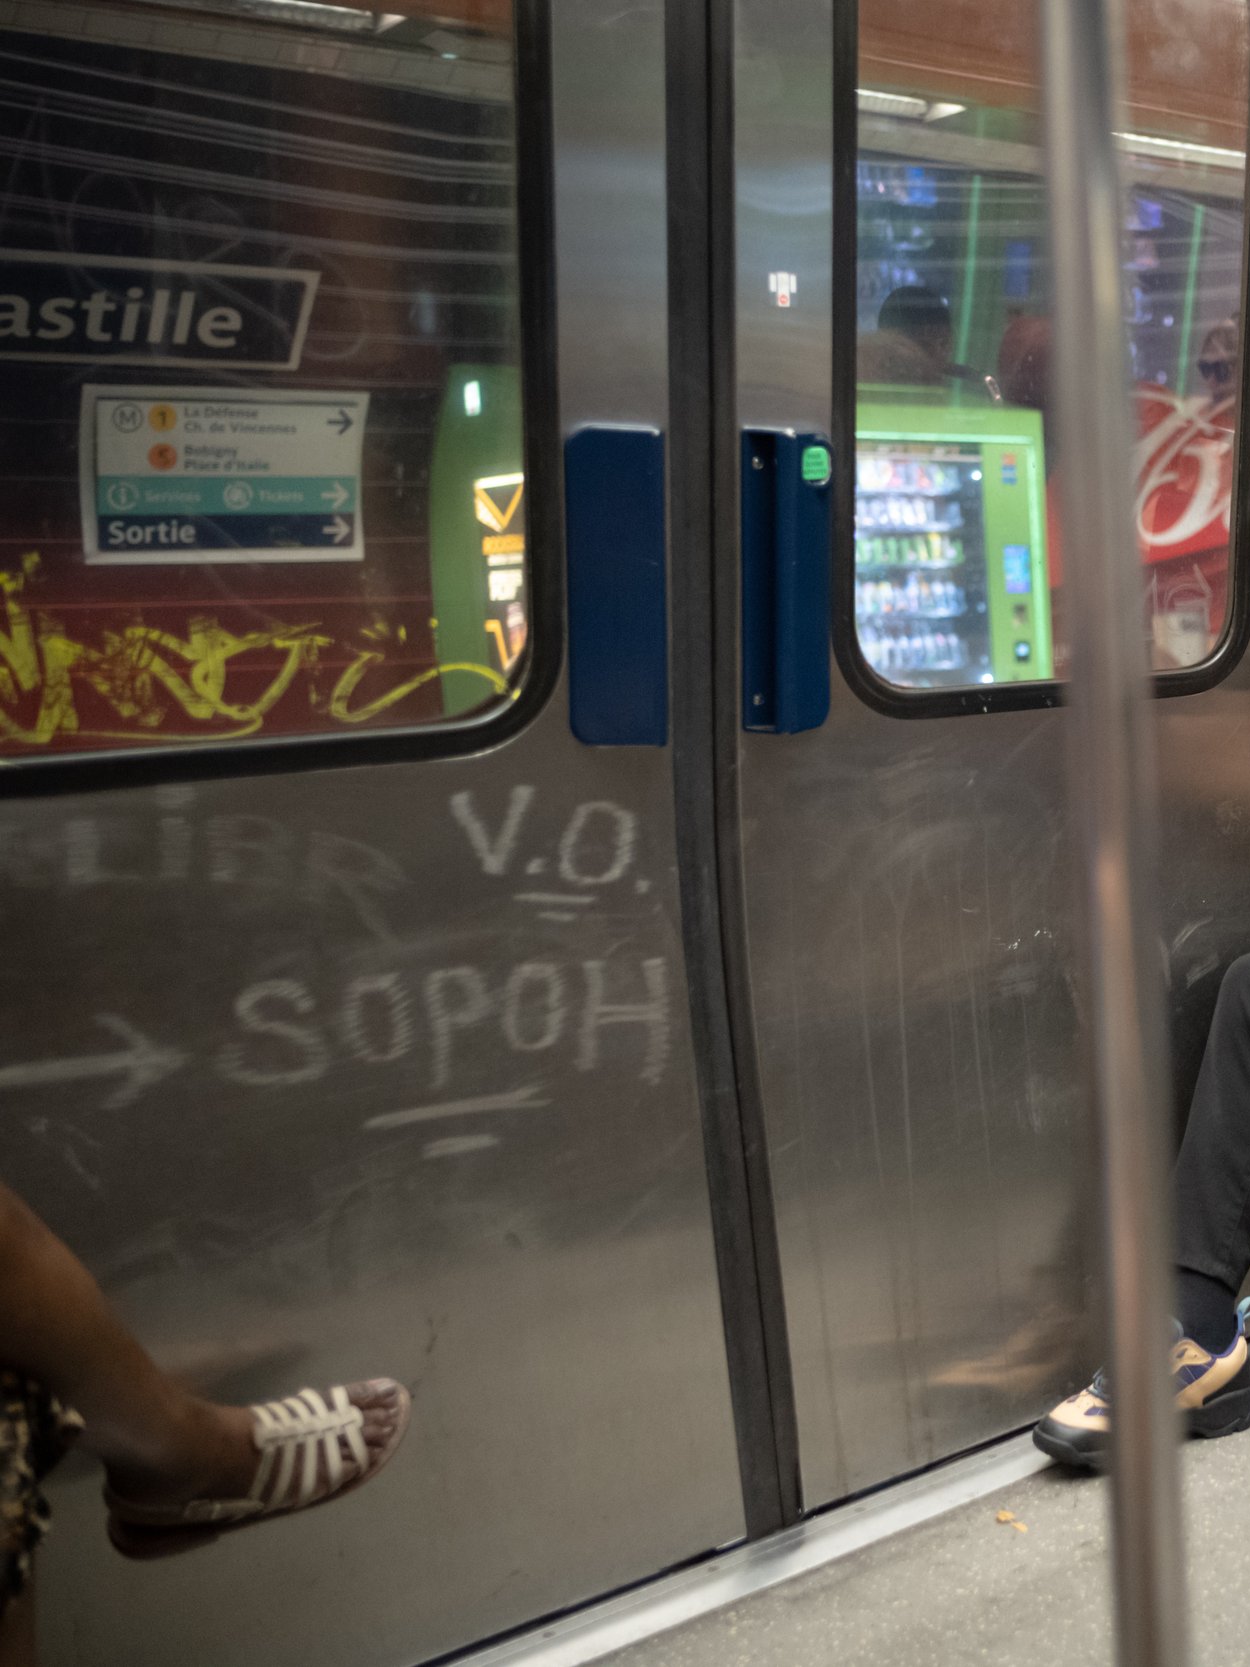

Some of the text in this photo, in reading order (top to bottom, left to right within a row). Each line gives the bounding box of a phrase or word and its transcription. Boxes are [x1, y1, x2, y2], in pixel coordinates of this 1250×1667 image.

[209, 421, 226, 434] de
[230, 422, 298, 434] Vincennes
[107, 519, 197, 545] Sortie
